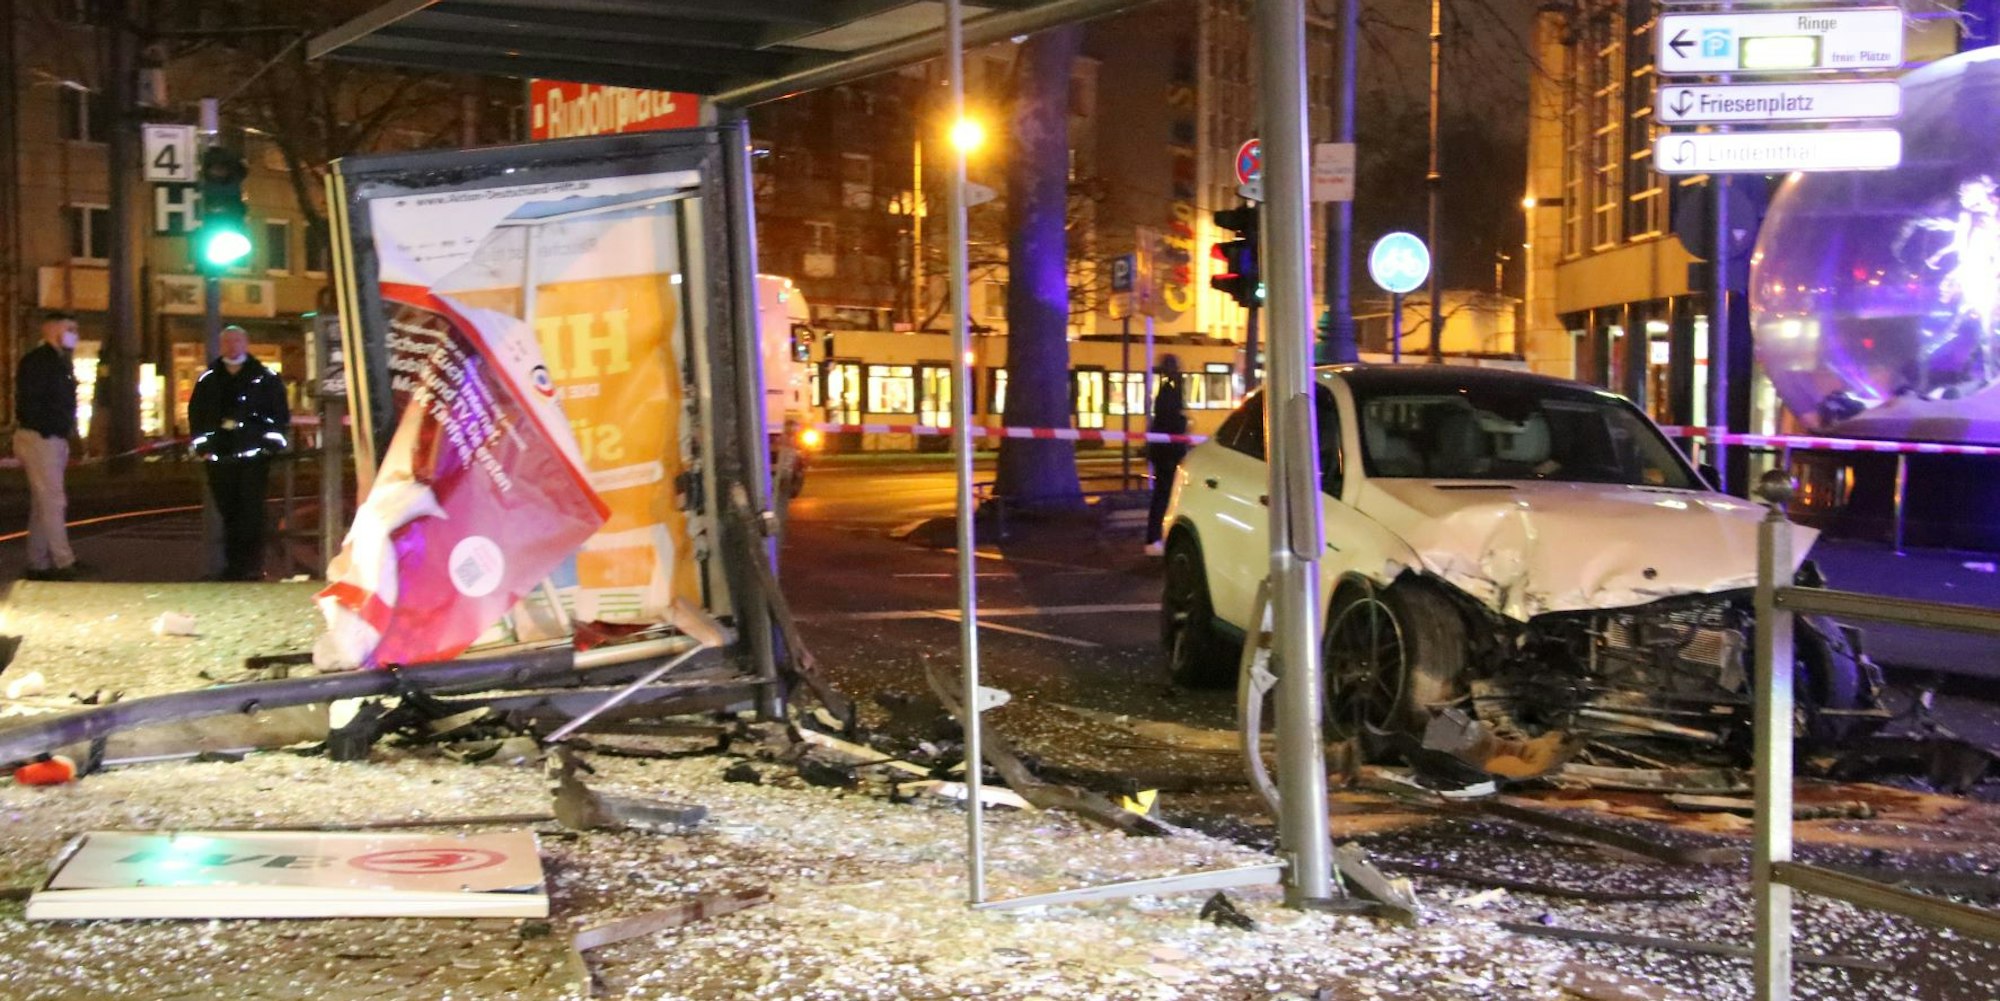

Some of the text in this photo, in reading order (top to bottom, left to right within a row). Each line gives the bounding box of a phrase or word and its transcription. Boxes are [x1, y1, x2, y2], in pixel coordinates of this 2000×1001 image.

[1798, 16, 1838, 32] Ringe
[1700, 92, 1814, 116] Friesenplatz
[154, 143, 183, 176] 4
[1708, 141, 1817, 162] Lindenthal
[154, 187, 195, 232] H
